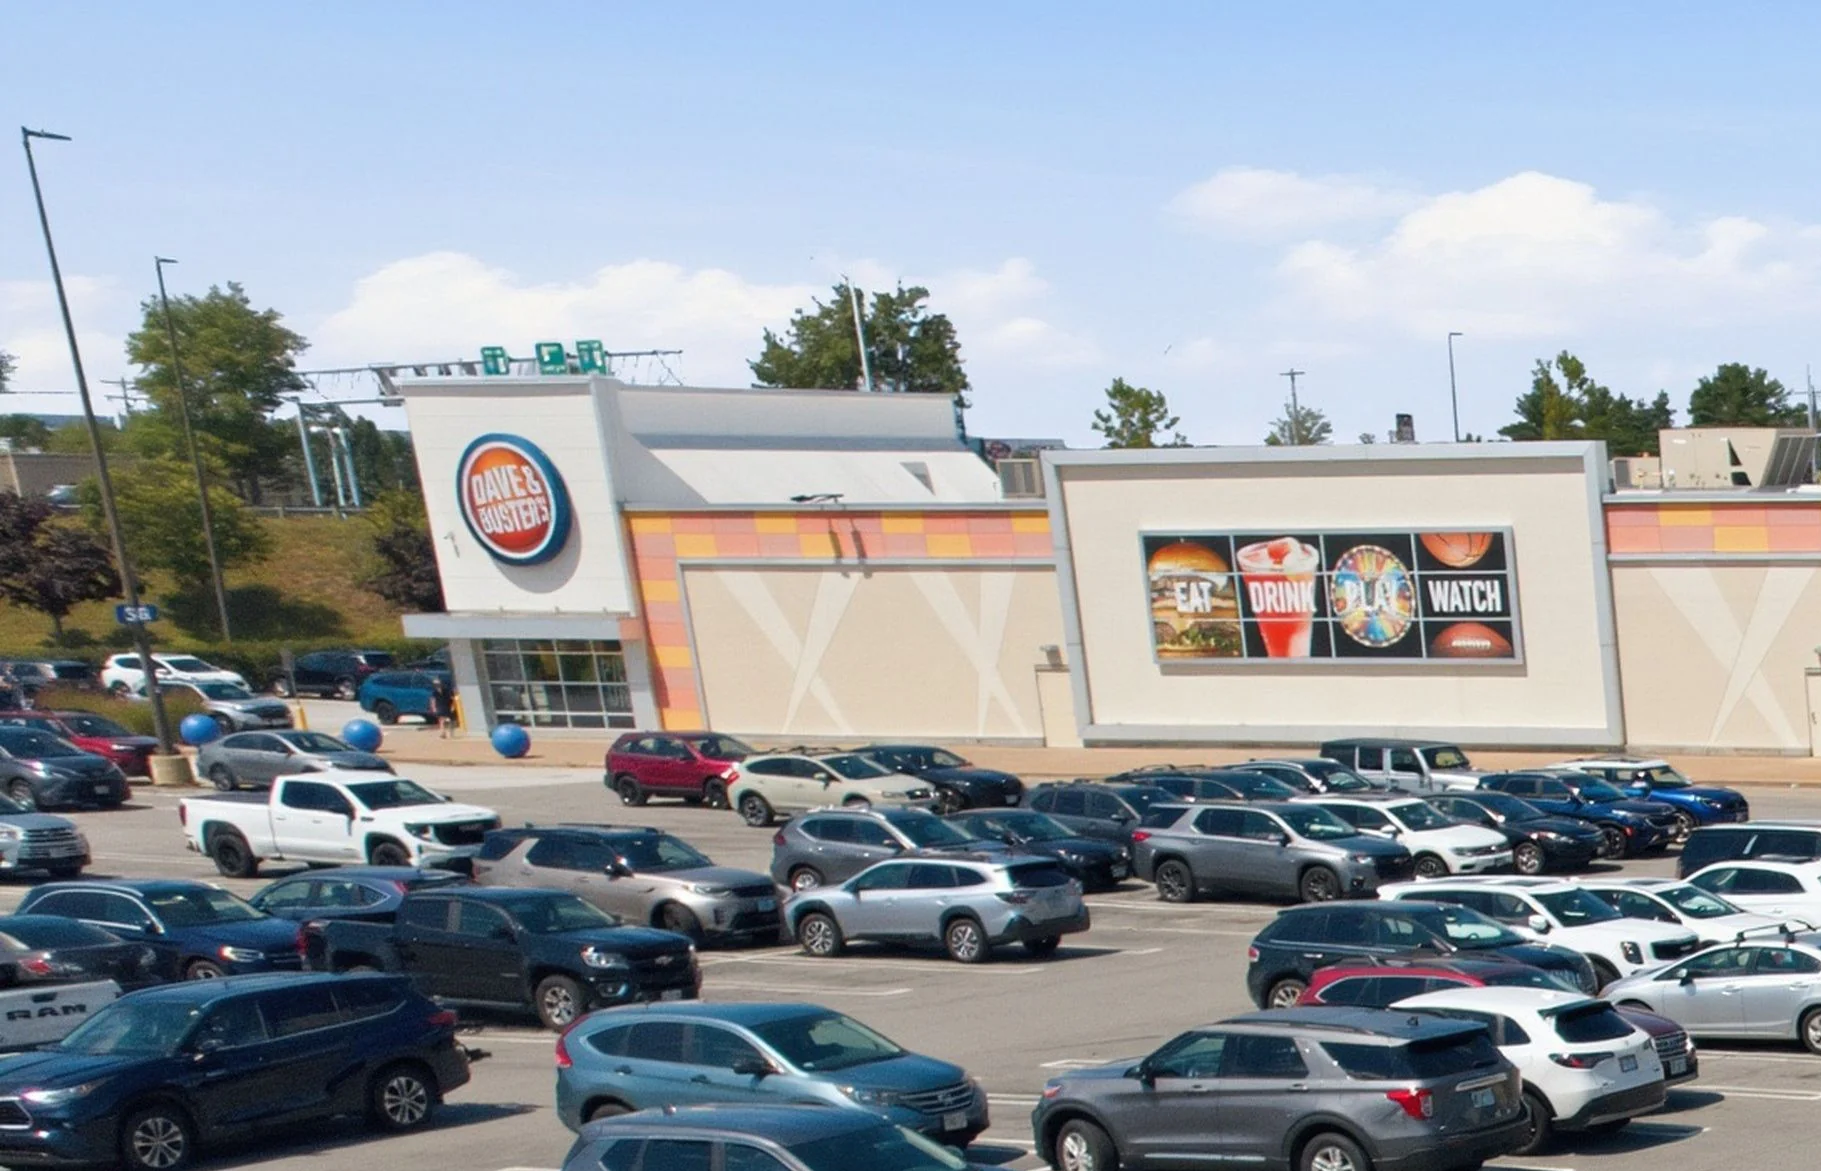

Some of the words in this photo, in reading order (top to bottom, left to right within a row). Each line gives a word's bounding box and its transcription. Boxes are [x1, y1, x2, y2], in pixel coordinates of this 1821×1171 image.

[471, 464, 528, 506] DAVE
[520, 465, 543, 494] &
[1174, 581, 1213, 613] EAT
[1248, 581, 1318, 614] DRINK
[1428, 580, 1502, 613] WATCH
[6, 1004, 87, 1020] RAM
